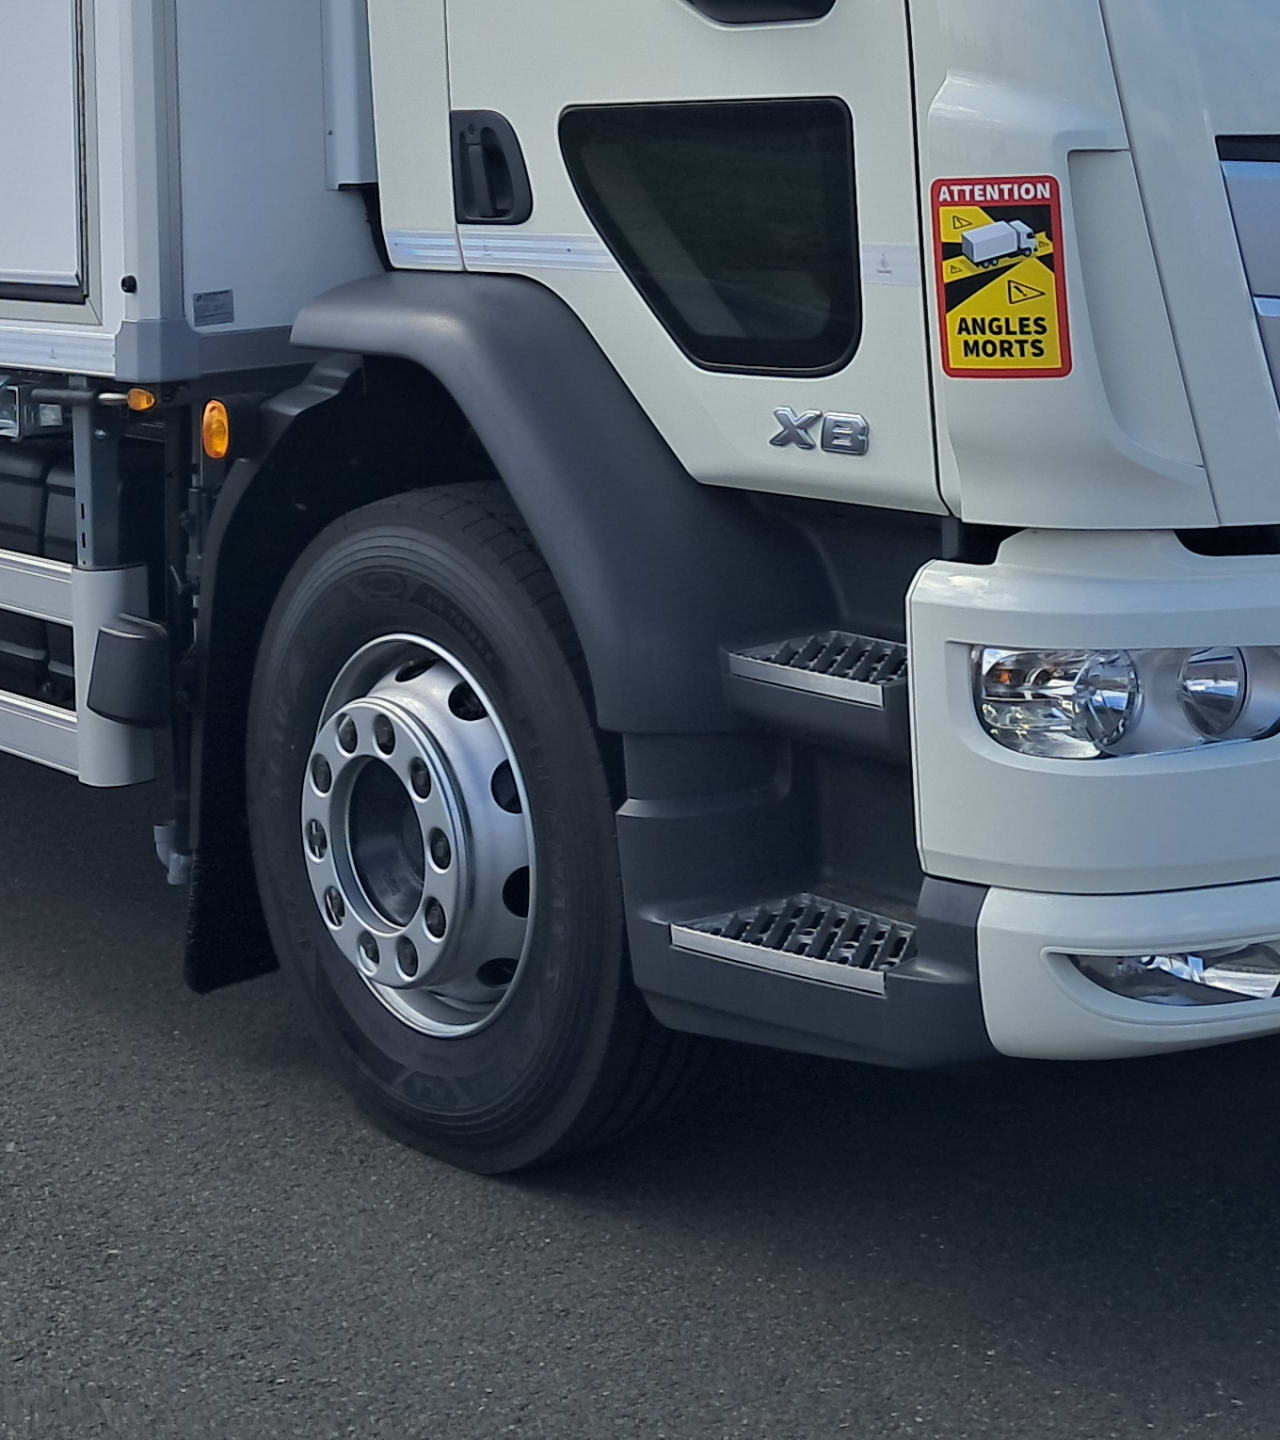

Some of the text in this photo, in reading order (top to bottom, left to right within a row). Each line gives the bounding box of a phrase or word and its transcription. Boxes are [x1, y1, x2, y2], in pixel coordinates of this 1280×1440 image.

[938, 182, 1051, 202] ATTENTION
[956, 317, 1047, 337] ANGLES
[963, 339, 1045, 358] MORTS
